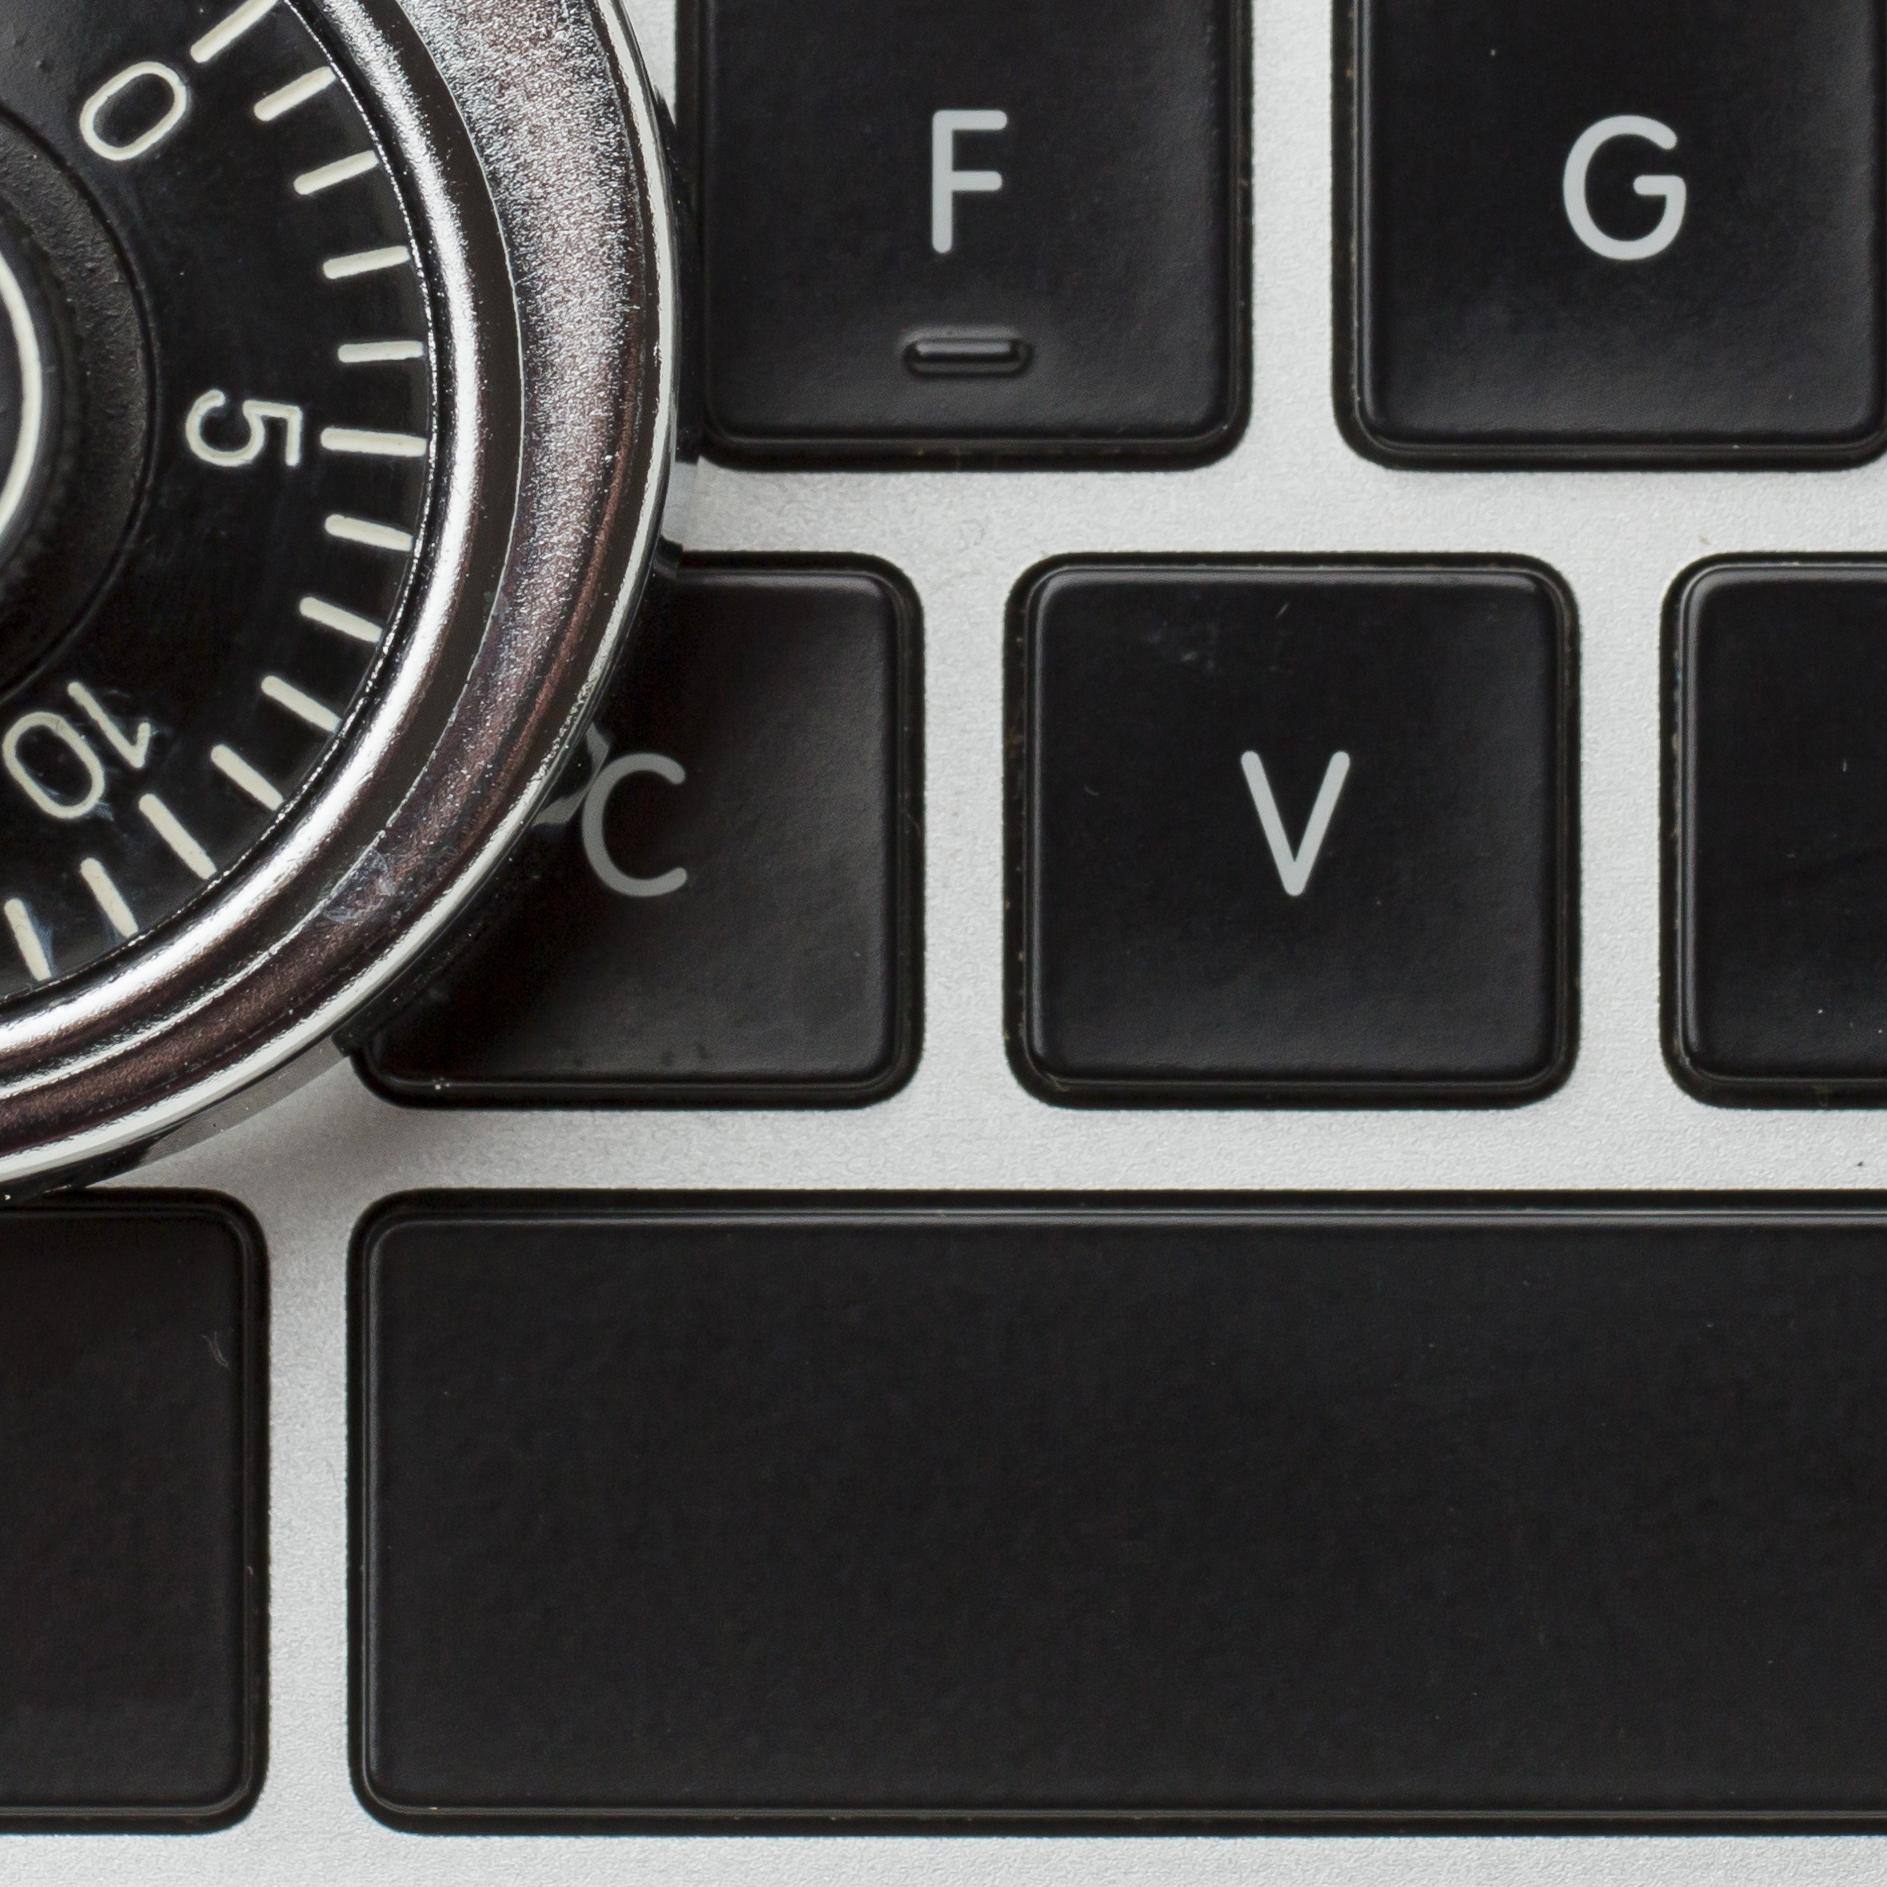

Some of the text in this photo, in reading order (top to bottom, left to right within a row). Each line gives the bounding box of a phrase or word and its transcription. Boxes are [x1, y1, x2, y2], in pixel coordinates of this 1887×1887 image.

[78, 61, 192, 162] 0
[931, 109, 1008, 254] F
[1562, 114, 1687, 261] G
[184, 388, 304, 468] 5
[2, 681, 151, 820] 10
[581, 752, 687, 897] C
[1240, 750, 1351, 897] V
